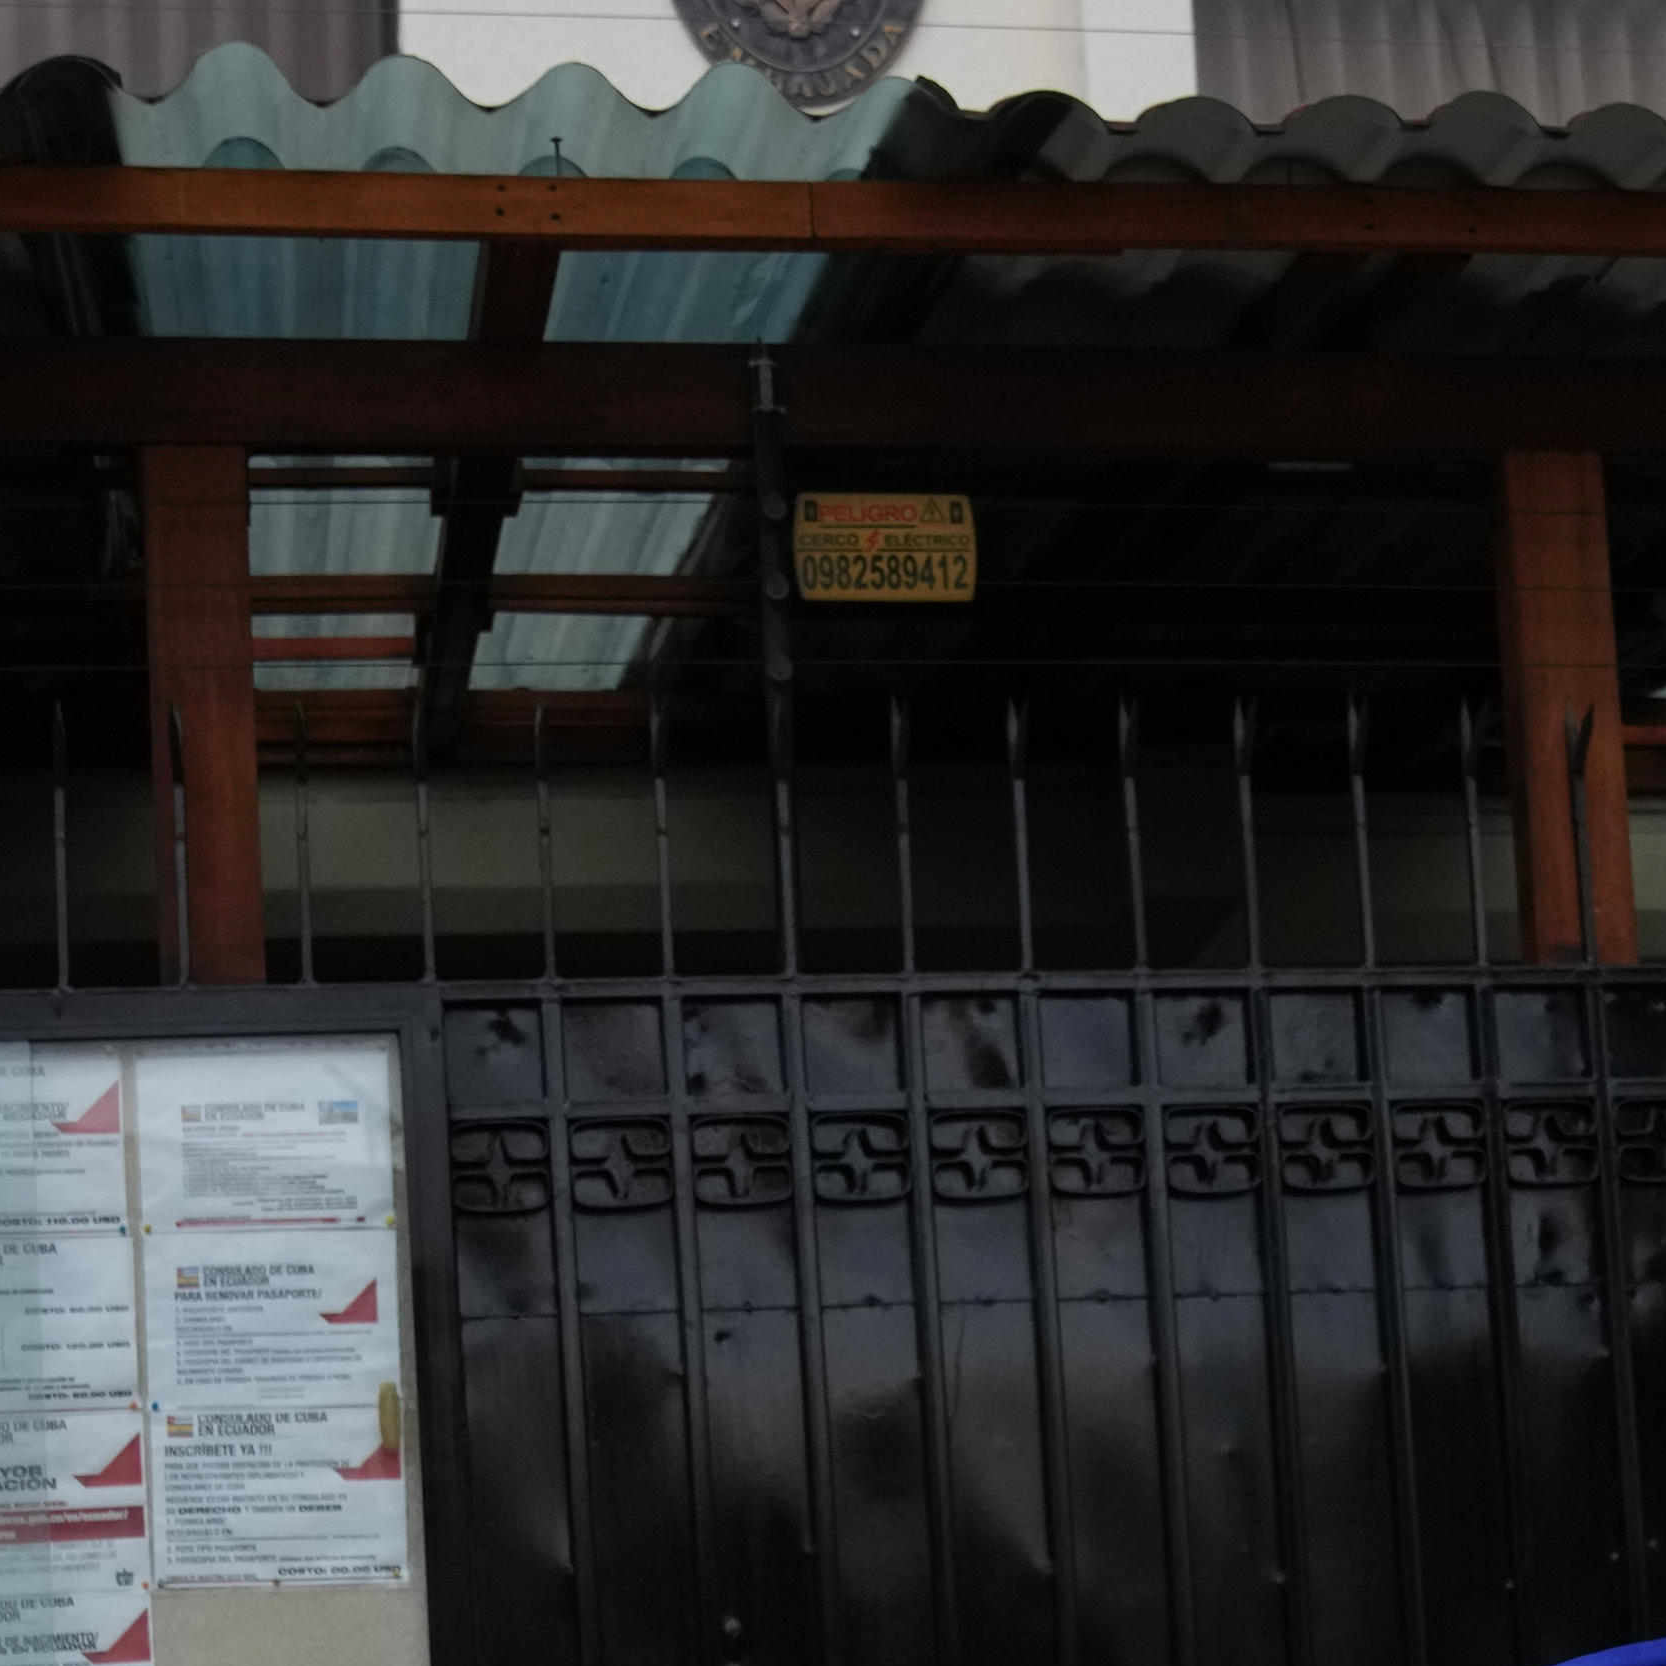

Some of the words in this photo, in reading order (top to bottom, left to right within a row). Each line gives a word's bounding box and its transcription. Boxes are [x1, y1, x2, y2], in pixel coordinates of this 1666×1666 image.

[800, 534, 859, 546] CERCO
[804, 554, 969, 590] 0982589412
[4, 1245, 19, 1255] DE
[175, 1292, 203, 1302] PARA
[276, 1413, 290, 1423] DE
[14, 1421, 29, 1431] DE
[240, 1444, 256, 1455] YA
